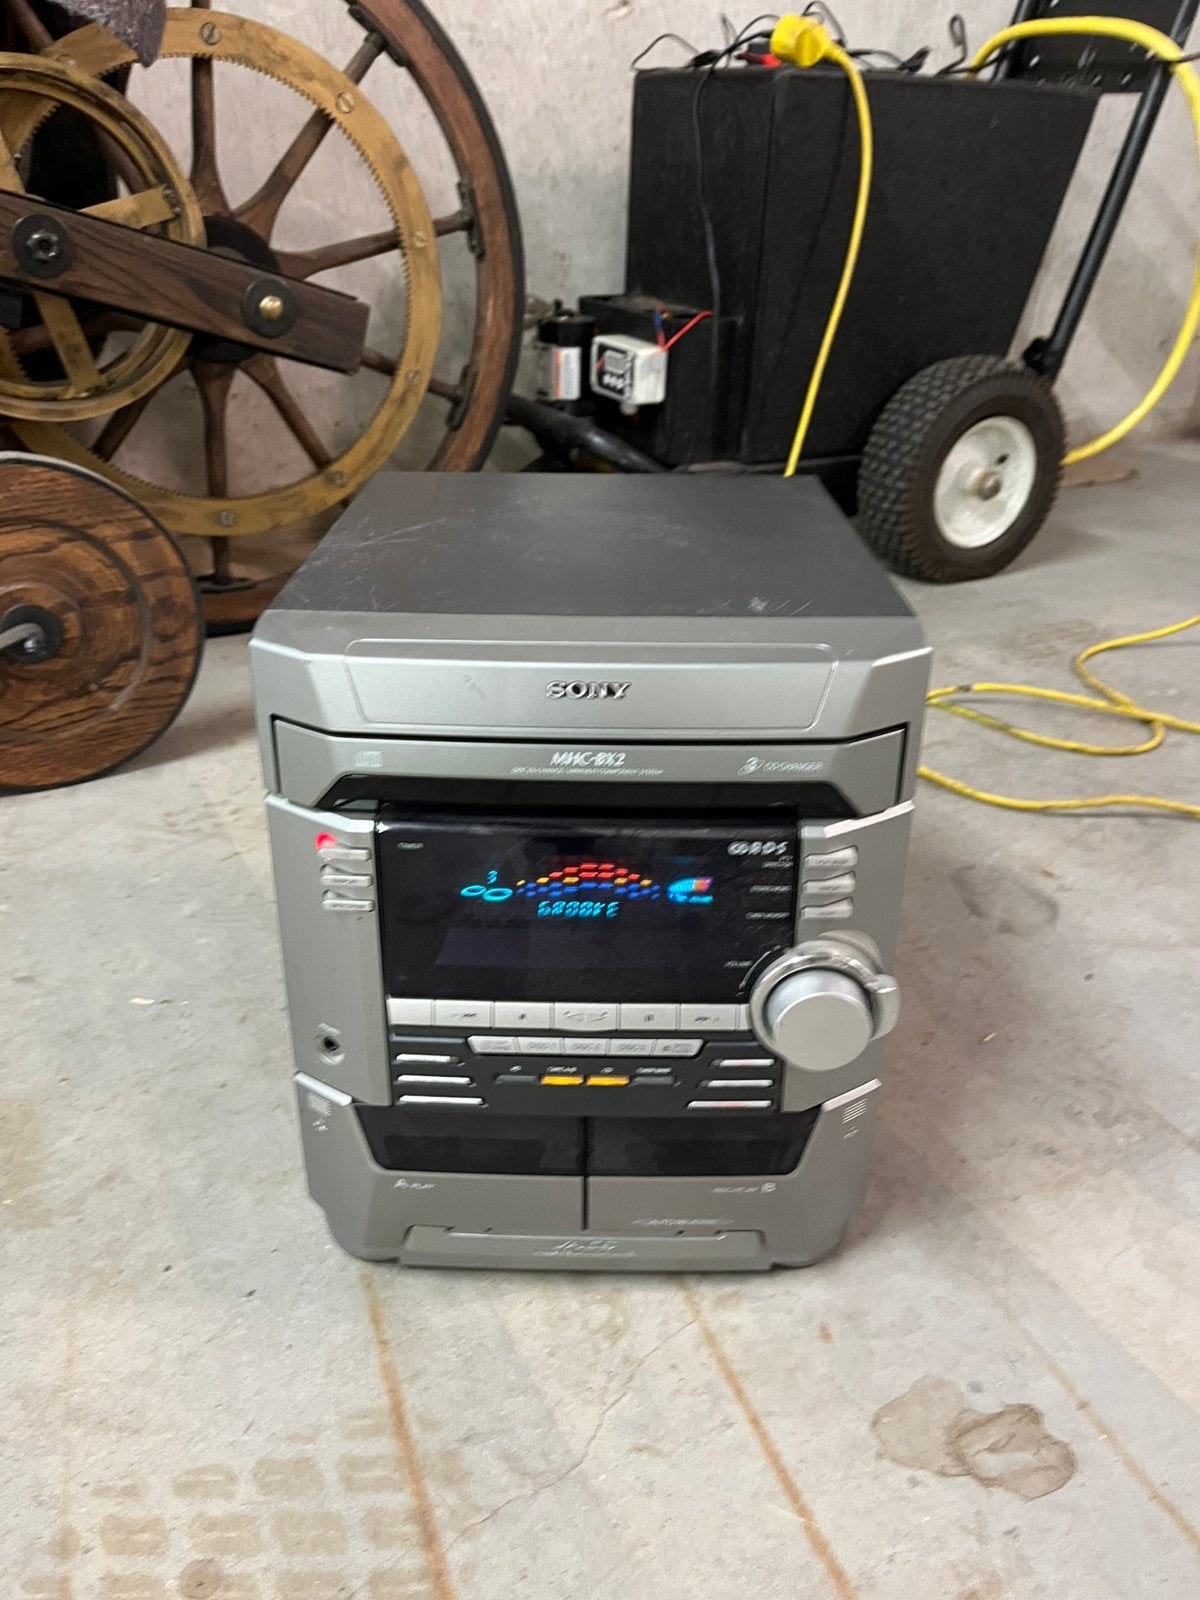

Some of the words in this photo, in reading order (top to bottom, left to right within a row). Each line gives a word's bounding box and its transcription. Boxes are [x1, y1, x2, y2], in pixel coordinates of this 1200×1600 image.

[546, 680, 632, 700] SONY
[550, 752, 626, 767] MHC-BX2
[537, 901, 620, 918] GROOVE
